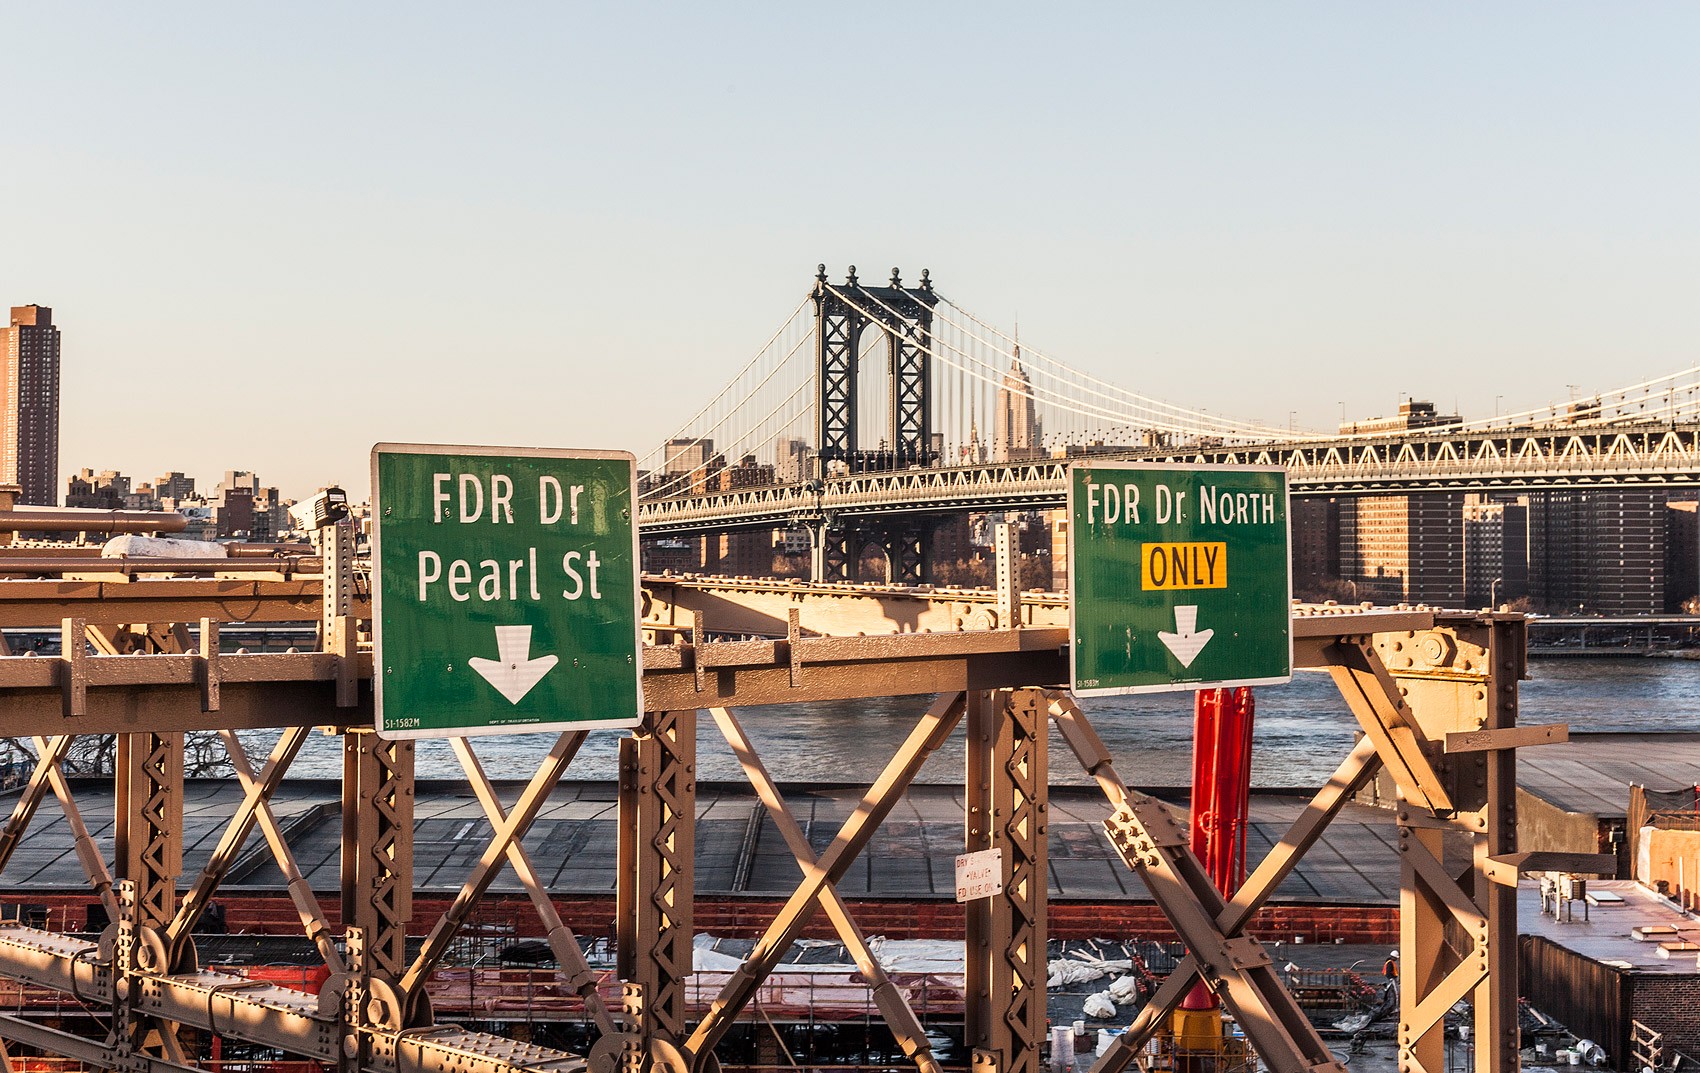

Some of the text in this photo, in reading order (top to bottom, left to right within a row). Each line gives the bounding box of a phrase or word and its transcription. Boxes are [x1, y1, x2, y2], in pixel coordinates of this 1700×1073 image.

[433, 473, 583, 525] FDR Dr
[1087, 483, 1275, 524] FDR Dr NORTH
[418, 547, 602, 602] Pearl St
[1150, 546, 1218, 586] ONLY
[385, 718, 419, 728] SI-1582M
